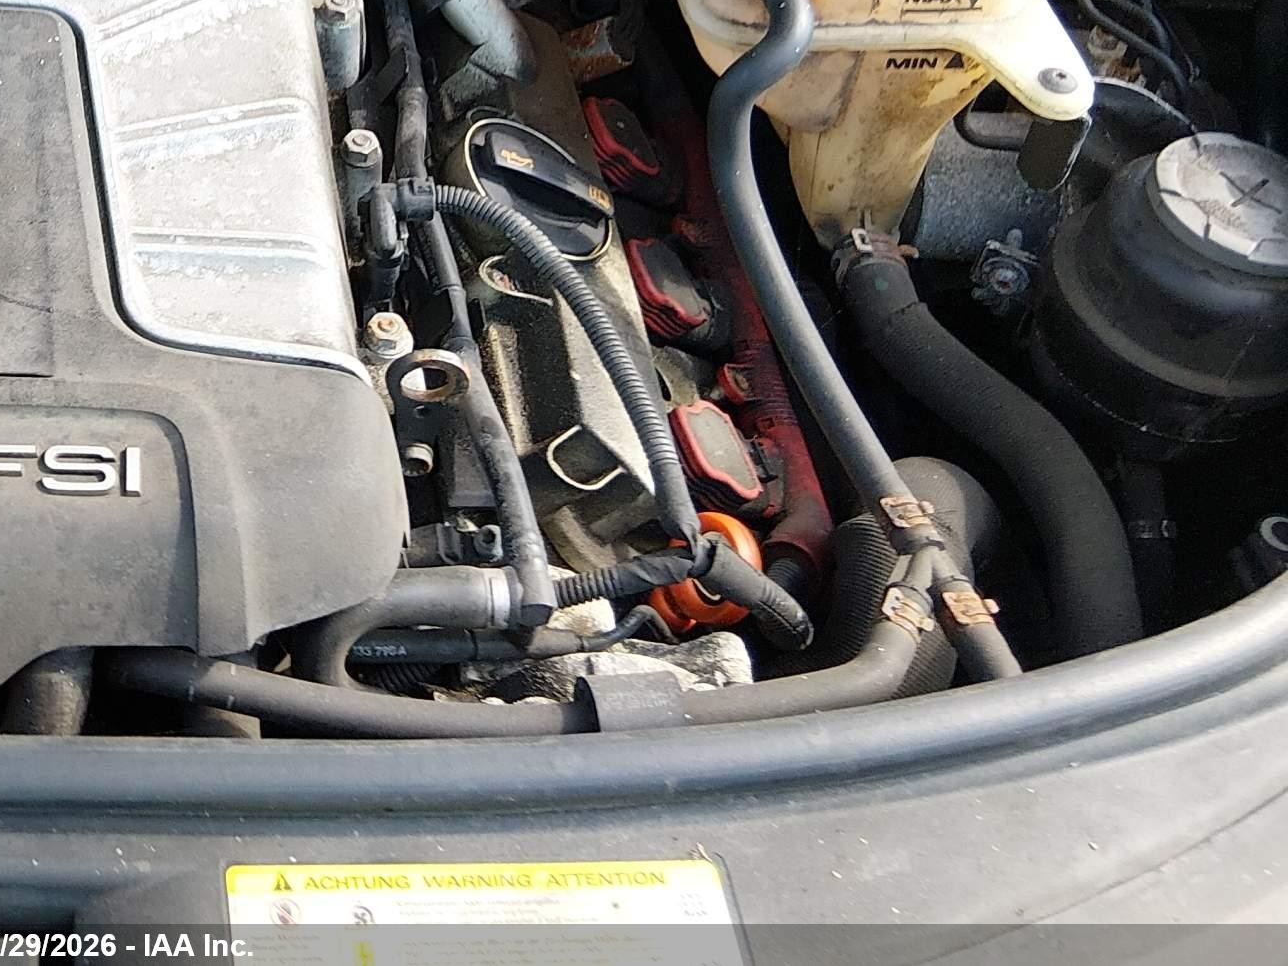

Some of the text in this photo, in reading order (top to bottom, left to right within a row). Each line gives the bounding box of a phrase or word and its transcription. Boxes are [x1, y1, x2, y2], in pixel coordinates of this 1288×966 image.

[886, 57, 937, 70] MIN
[304, 871, 667, 891] ACHTUNG WARNING ATTENTION
